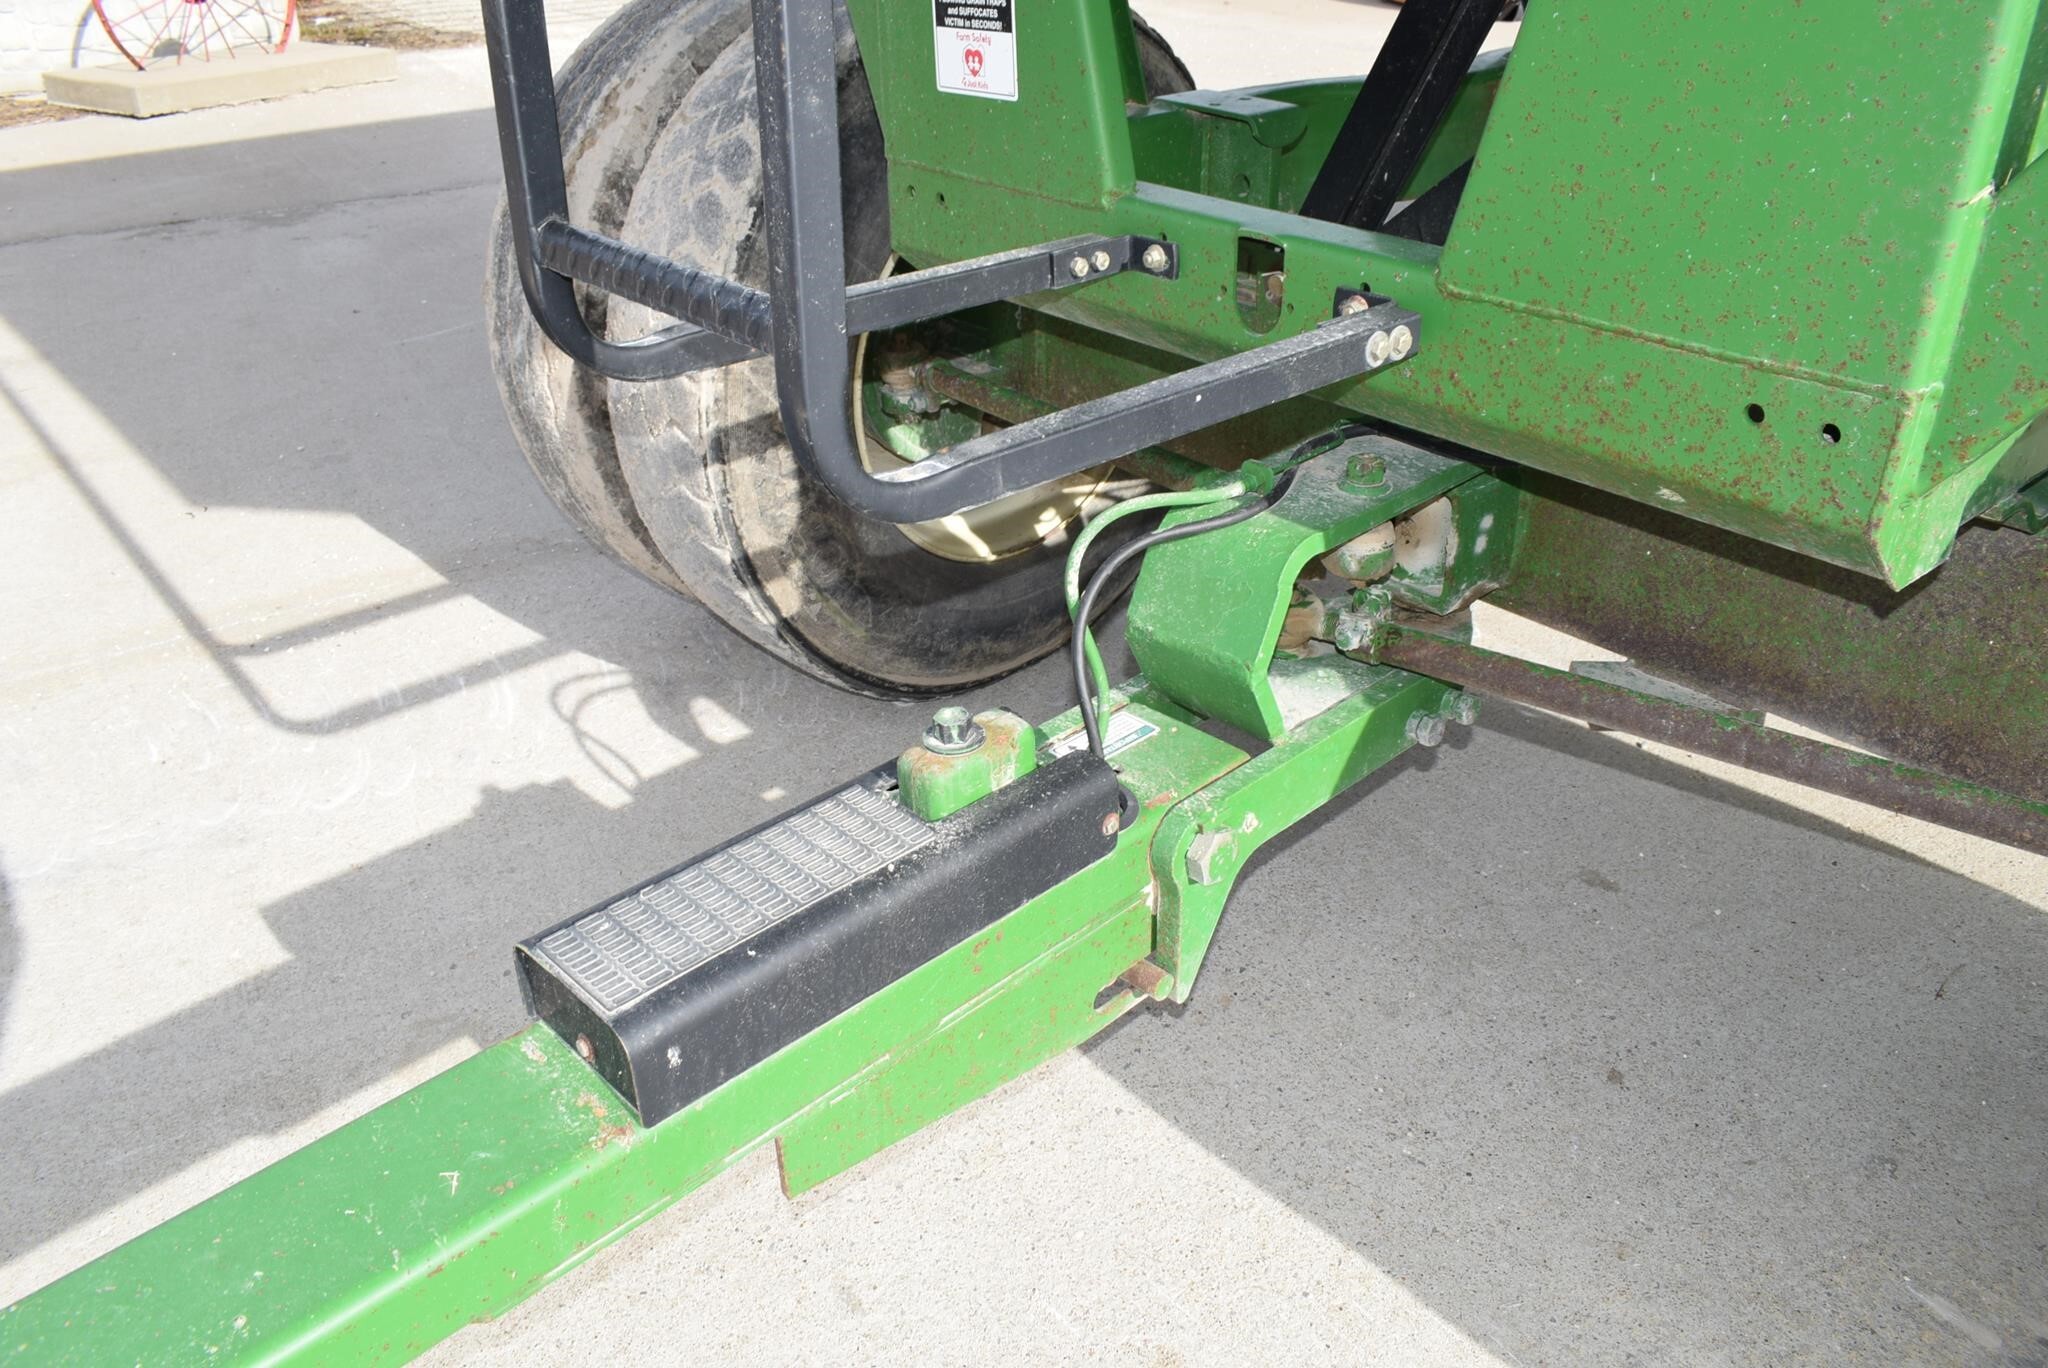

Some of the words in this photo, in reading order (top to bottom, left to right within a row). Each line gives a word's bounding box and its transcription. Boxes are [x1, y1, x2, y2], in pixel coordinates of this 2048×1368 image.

[947, 7, 958, 15] and
[959, 6, 998, 18] SUFFOCATES
[944, 17, 964, 26] VICTIM
[964, 19, 971, 28] in
[972, 19, 1002, 31] SECONDS!
[956, 31, 970, 41] Farm
[972, 32, 991, 46] Safety
